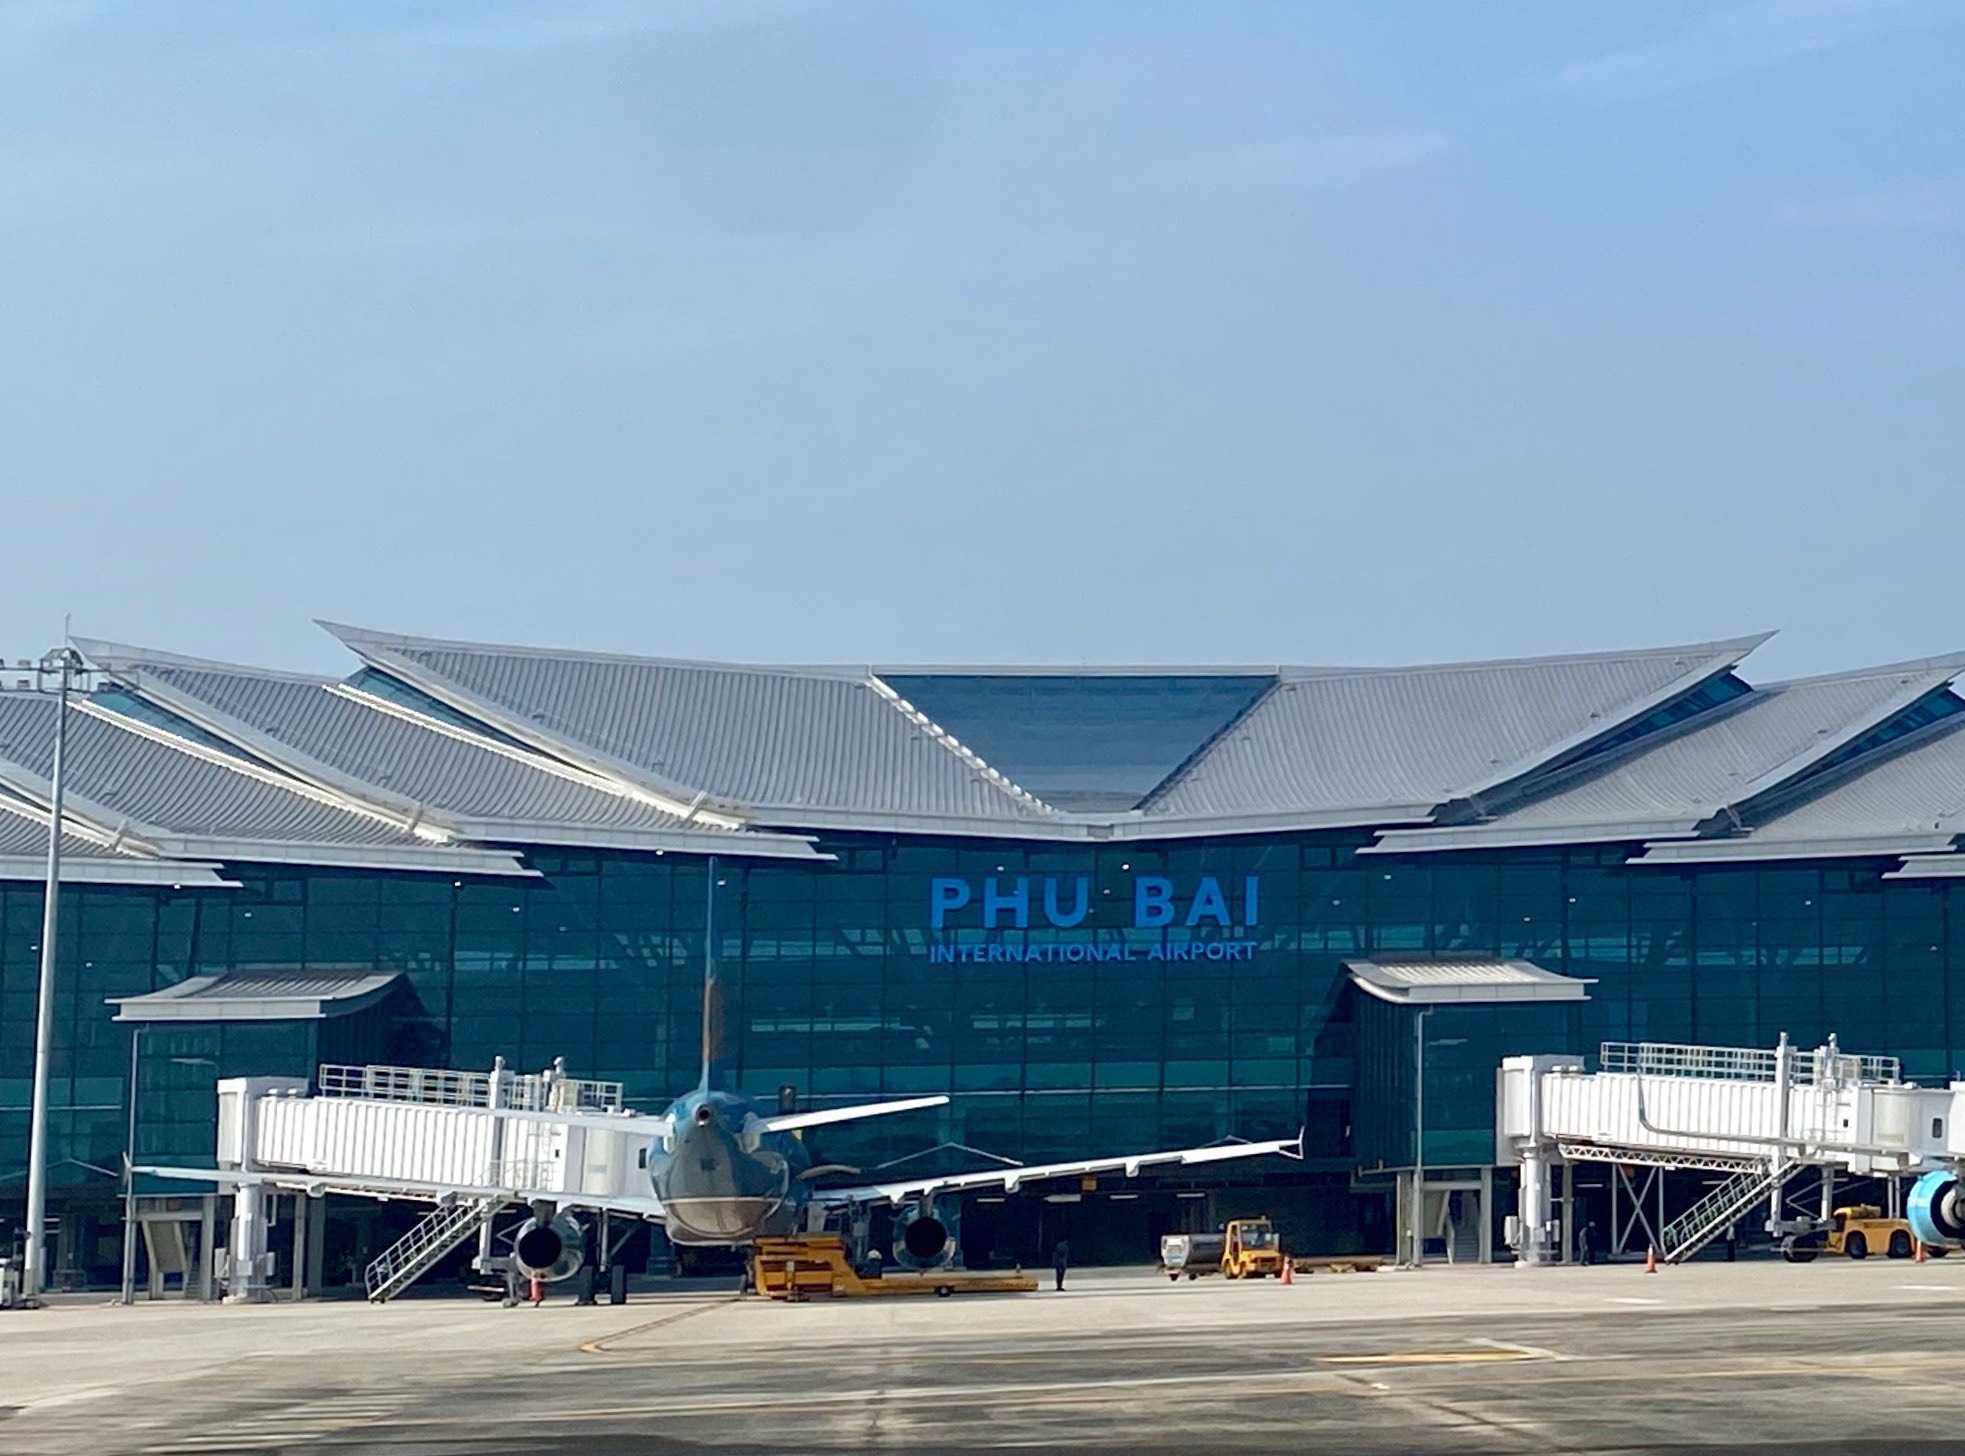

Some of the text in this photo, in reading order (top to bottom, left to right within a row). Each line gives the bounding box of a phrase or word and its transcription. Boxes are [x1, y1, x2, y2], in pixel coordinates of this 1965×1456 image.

[931, 876, 1258, 928] PHU BAI
[930, 941, 1257, 963] INTERNATIONAL AIRPORT
